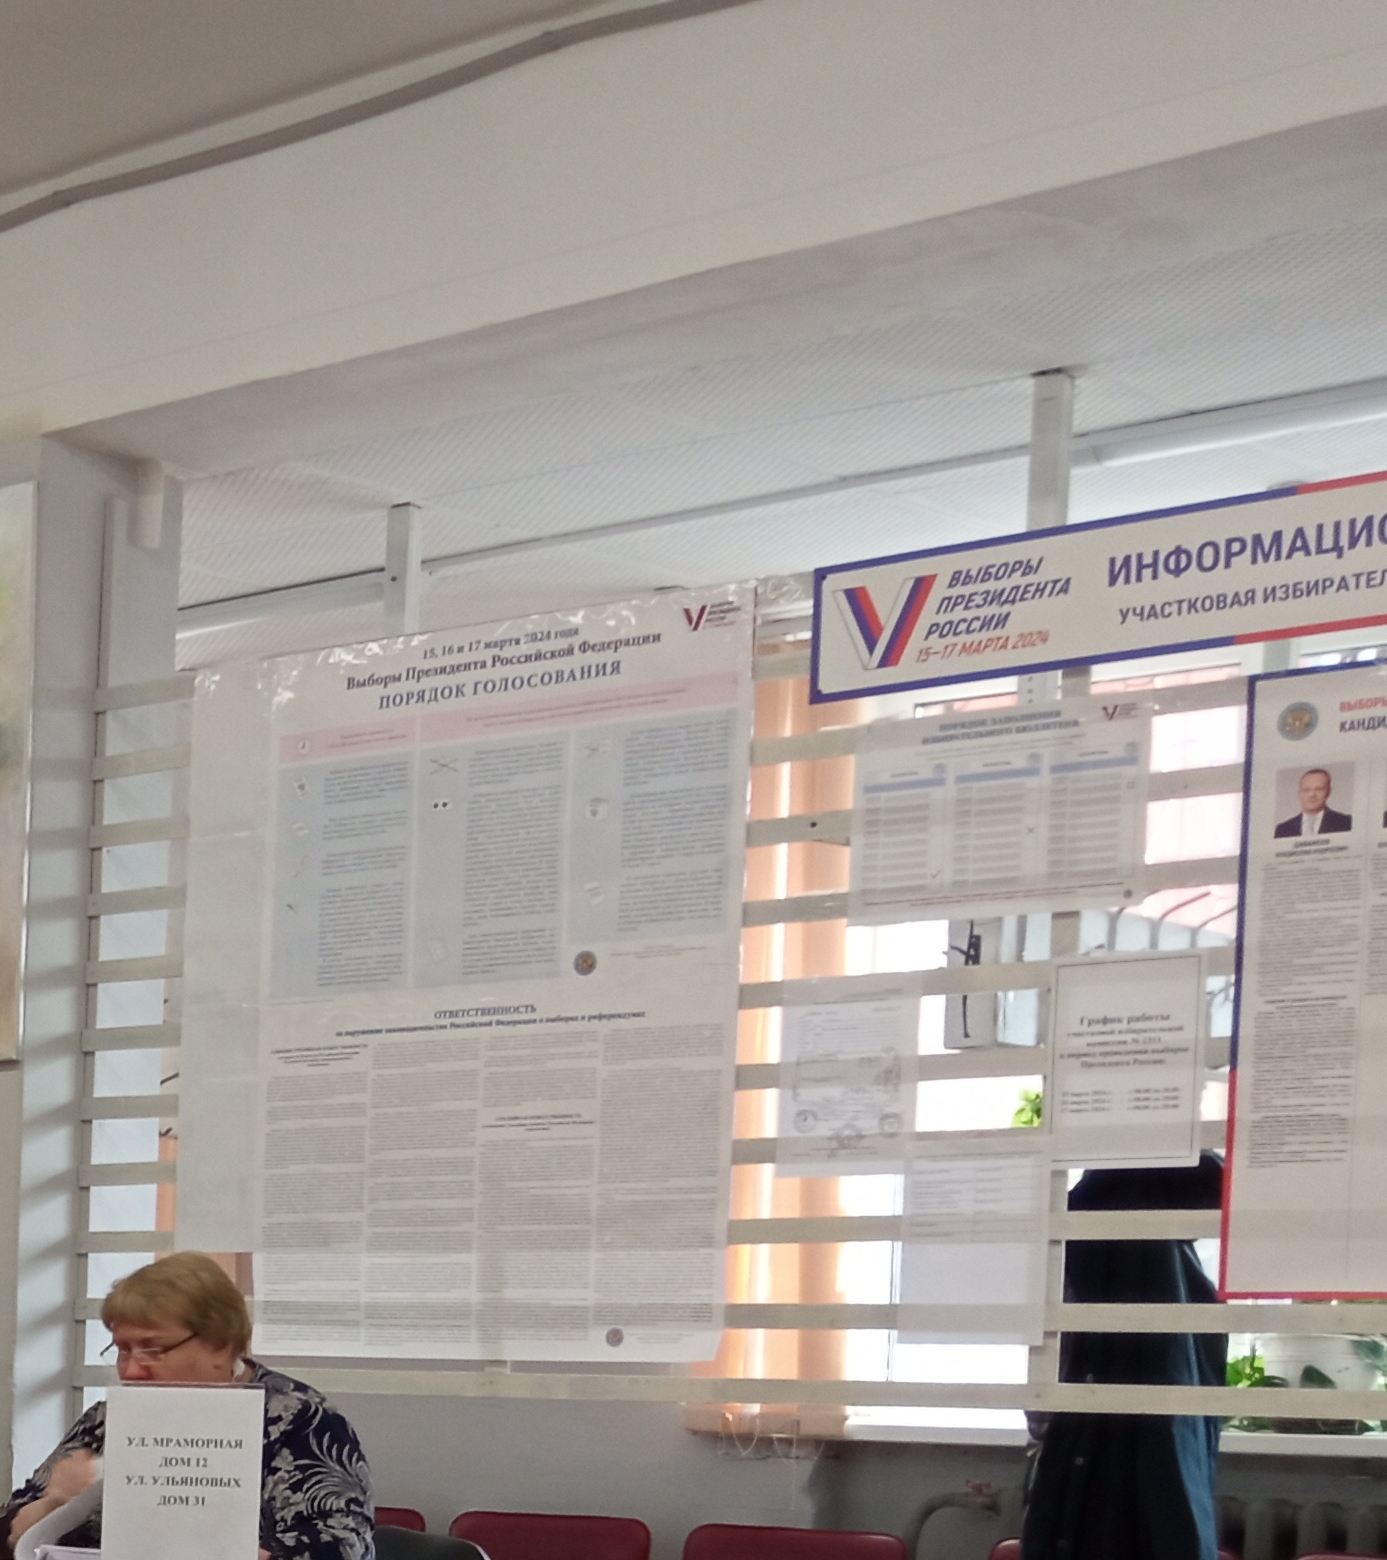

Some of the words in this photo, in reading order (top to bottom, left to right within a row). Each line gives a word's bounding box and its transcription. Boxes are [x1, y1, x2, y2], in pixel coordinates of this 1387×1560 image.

[947, 556, 1044, 589] ВЫБОРЫ
[935, 577, 1072, 615] ПРЕЗИДЕНТА
[1119, 588, 1257, 625] УЧАСТКОВАЯ
[924, 611, 1011, 641] РОССИИ
[423, 648, 438, 661] 15,
[441, 644, 455, 657] 16
[456, 645, 465, 654] и
[468, 640, 482, 652] 17
[483, 636, 521, 651] марта
[524, 630, 551, 645] 2024
[554, 627, 579, 641] года
[958, 636, 1010, 658] МАРТА
[1012, 630, 1050, 650] 2024
[346, 671, 402, 690] Выборы
[405, 658, 487, 683] Президента
[491, 644, 575, 668] Российской
[578, 633, 662, 654] Федерации
[378, 683, 466, 710] ПОРЯДОК
[472, 660, 622, 696] ГОЛОСОВАНИЯ
[1339, 716, 1387, 733] КАНДИ
[434, 1004, 537, 1020] ОТВЕТСТВЕННОСТЬ
[1080, 1015, 1123, 1027] График
[1127, 1013, 1170, 1025] работы
[126, 1437, 149, 1448] УЛ.
[153, 1437, 243, 1449] МРАМОРНАЯ
[159, 1457, 191, 1468] ДОМ
[195, 1457, 208, 1468] 12
[125, 1475, 147, 1486] УЛ.
[152, 1476, 242, 1488] УЛЬЯНОВЫХ
[157, 1495, 190, 1507] ДОМ
[193, 1496, 206, 1506] 31
